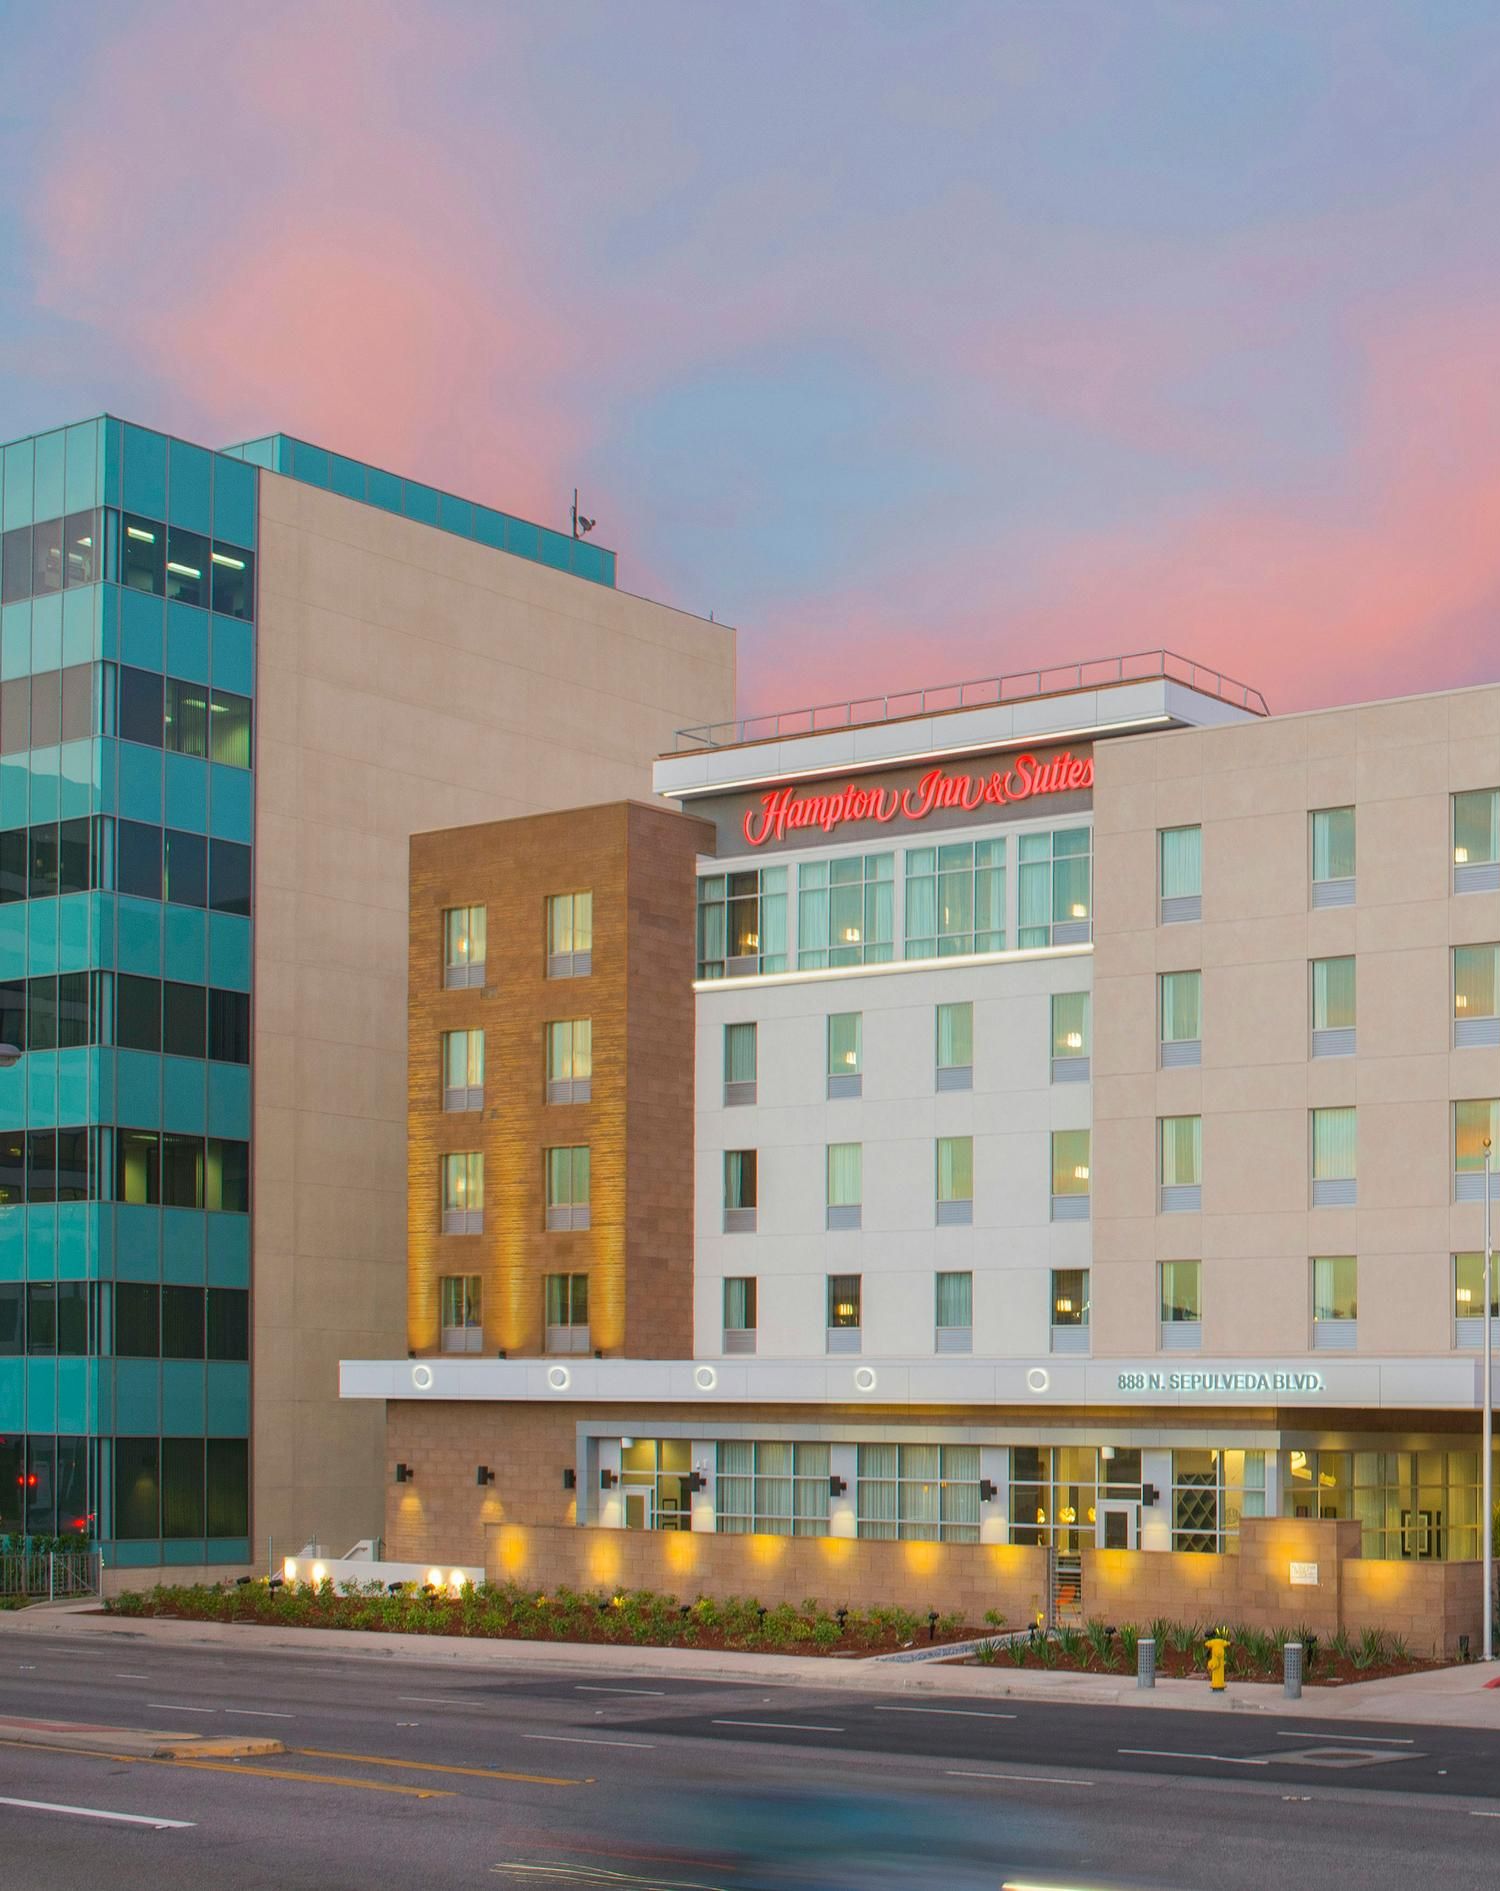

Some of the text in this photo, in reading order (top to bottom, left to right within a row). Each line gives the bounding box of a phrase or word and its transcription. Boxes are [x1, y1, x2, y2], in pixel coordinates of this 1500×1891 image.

[744, 752, 1094, 846] Hampton Inn & Suites
[1118, 1374, 1325, 1390] 888 N. SEPULVEDA BLVD.
